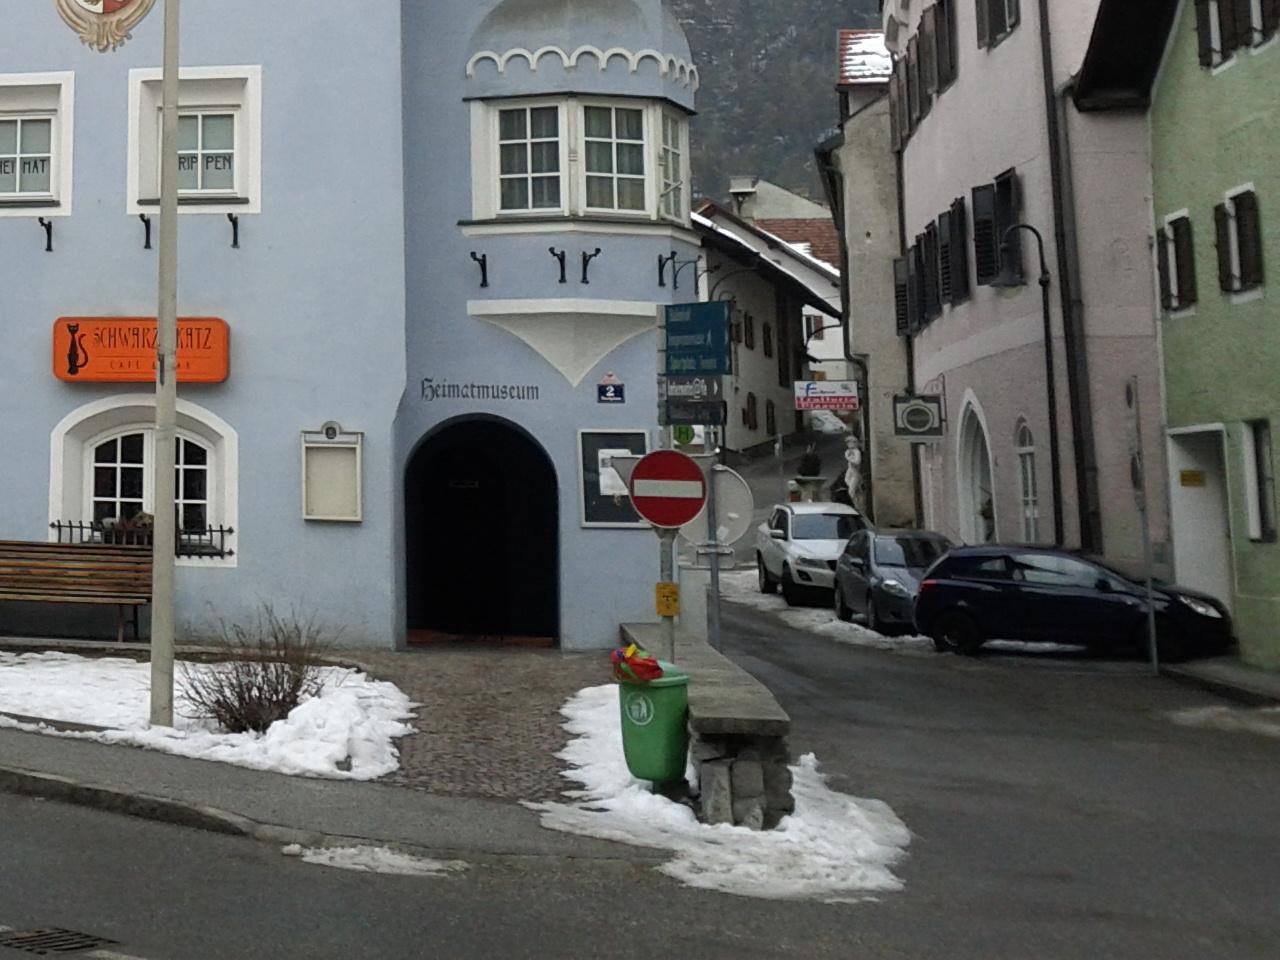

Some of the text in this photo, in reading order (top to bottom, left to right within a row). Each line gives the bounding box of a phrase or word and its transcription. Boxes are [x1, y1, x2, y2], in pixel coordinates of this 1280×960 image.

[178, 155, 232, 171] RIPPEN
[92, 327, 212, 350] SCHWARZ KATZ
[421, 377, 539, 401] Heimatmuseum
[605, 384, 615, 397] 2
